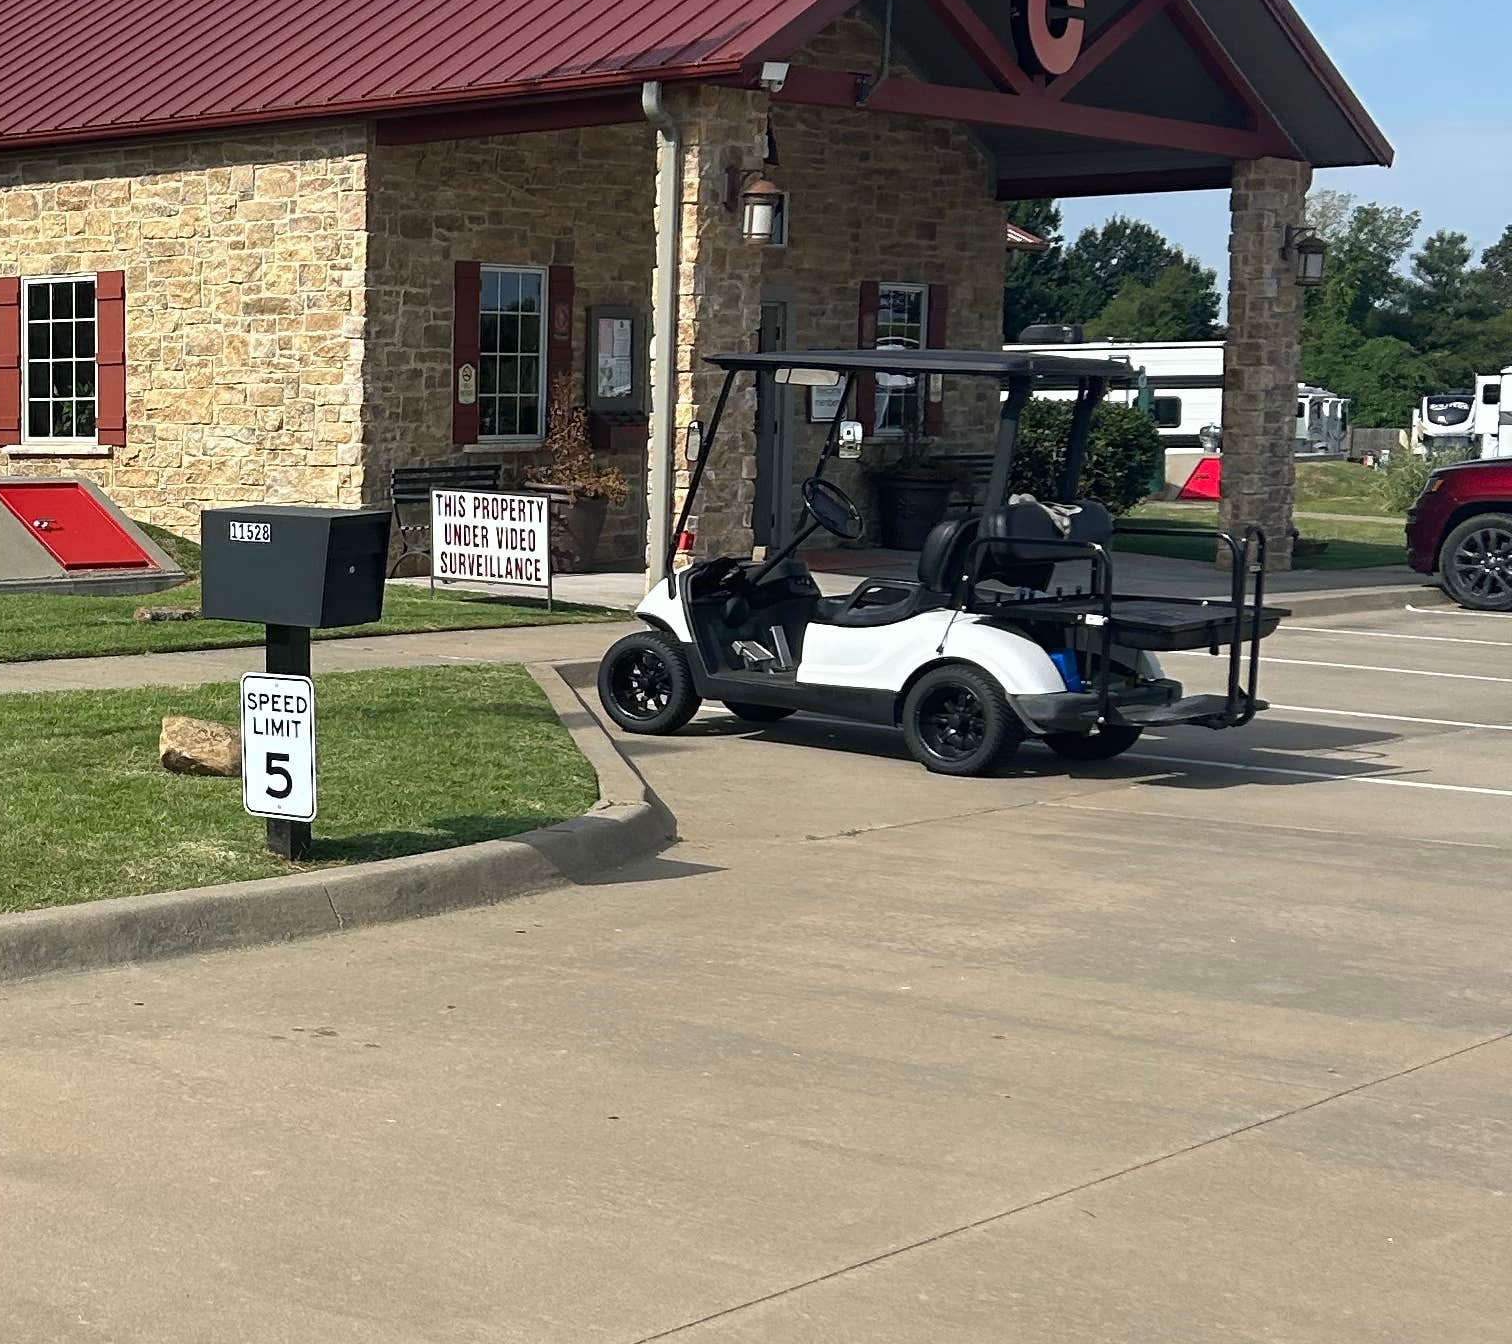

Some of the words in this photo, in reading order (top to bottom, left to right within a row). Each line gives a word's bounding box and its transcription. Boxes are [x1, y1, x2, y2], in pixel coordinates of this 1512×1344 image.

[435, 493, 466, 518] THIS
[473, 496, 544, 523] PROPERTY
[231, 522, 270, 541] 11528
[444, 523, 489, 549] UNDER
[496, 526, 536, 553] VIDEO
[440, 551, 542, 582] SURVEILLANCE
[247, 692, 308, 714] SPEED
[252, 716, 302, 739] LIMIT
[265, 751, 293, 799] 5
